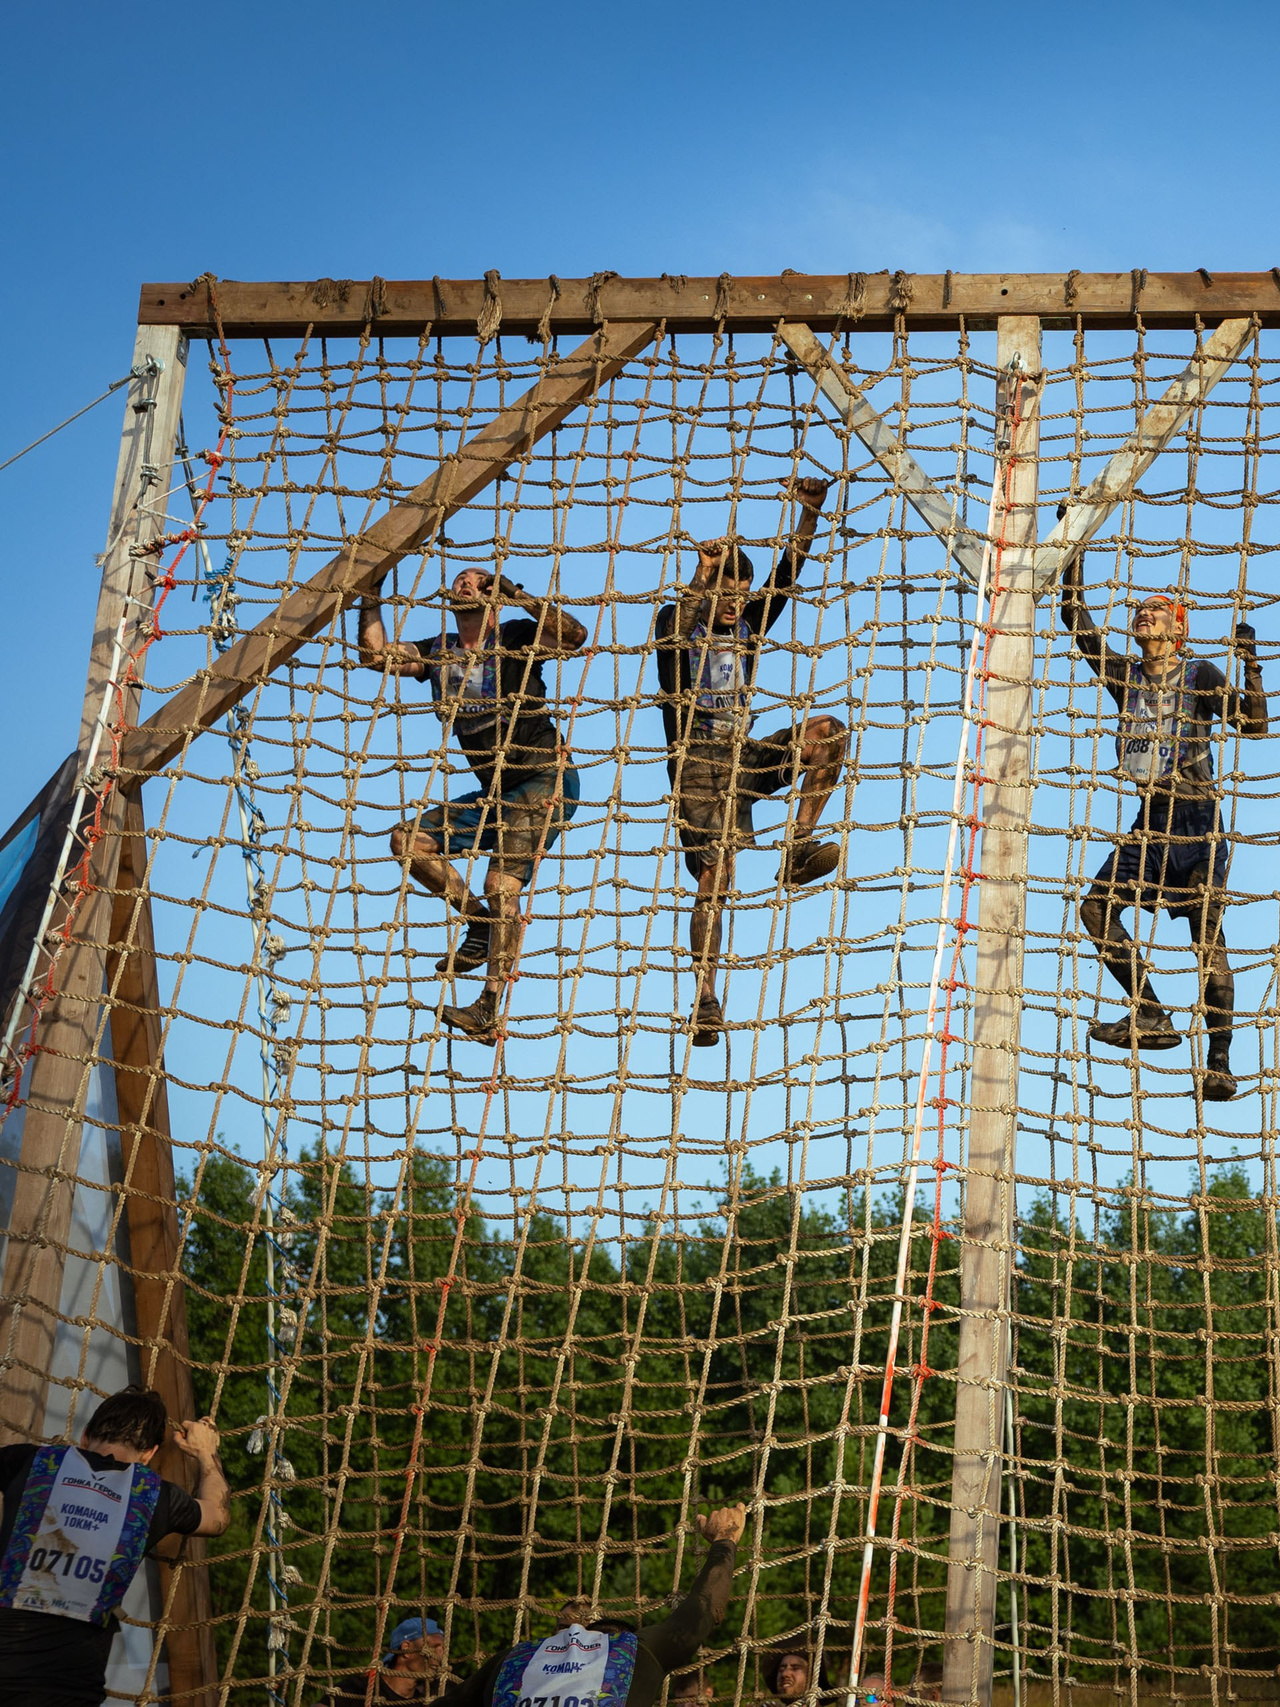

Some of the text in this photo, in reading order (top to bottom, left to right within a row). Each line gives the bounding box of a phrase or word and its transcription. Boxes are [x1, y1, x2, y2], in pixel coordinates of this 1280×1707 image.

[62, 1477, 122, 1500] ГОНКА ГЕРОЕВ
[60, 1503, 109, 1524] КОМАНДА
[64, 1516, 100, 1531] 10КМ+
[29, 1548, 107, 1584] 07105
